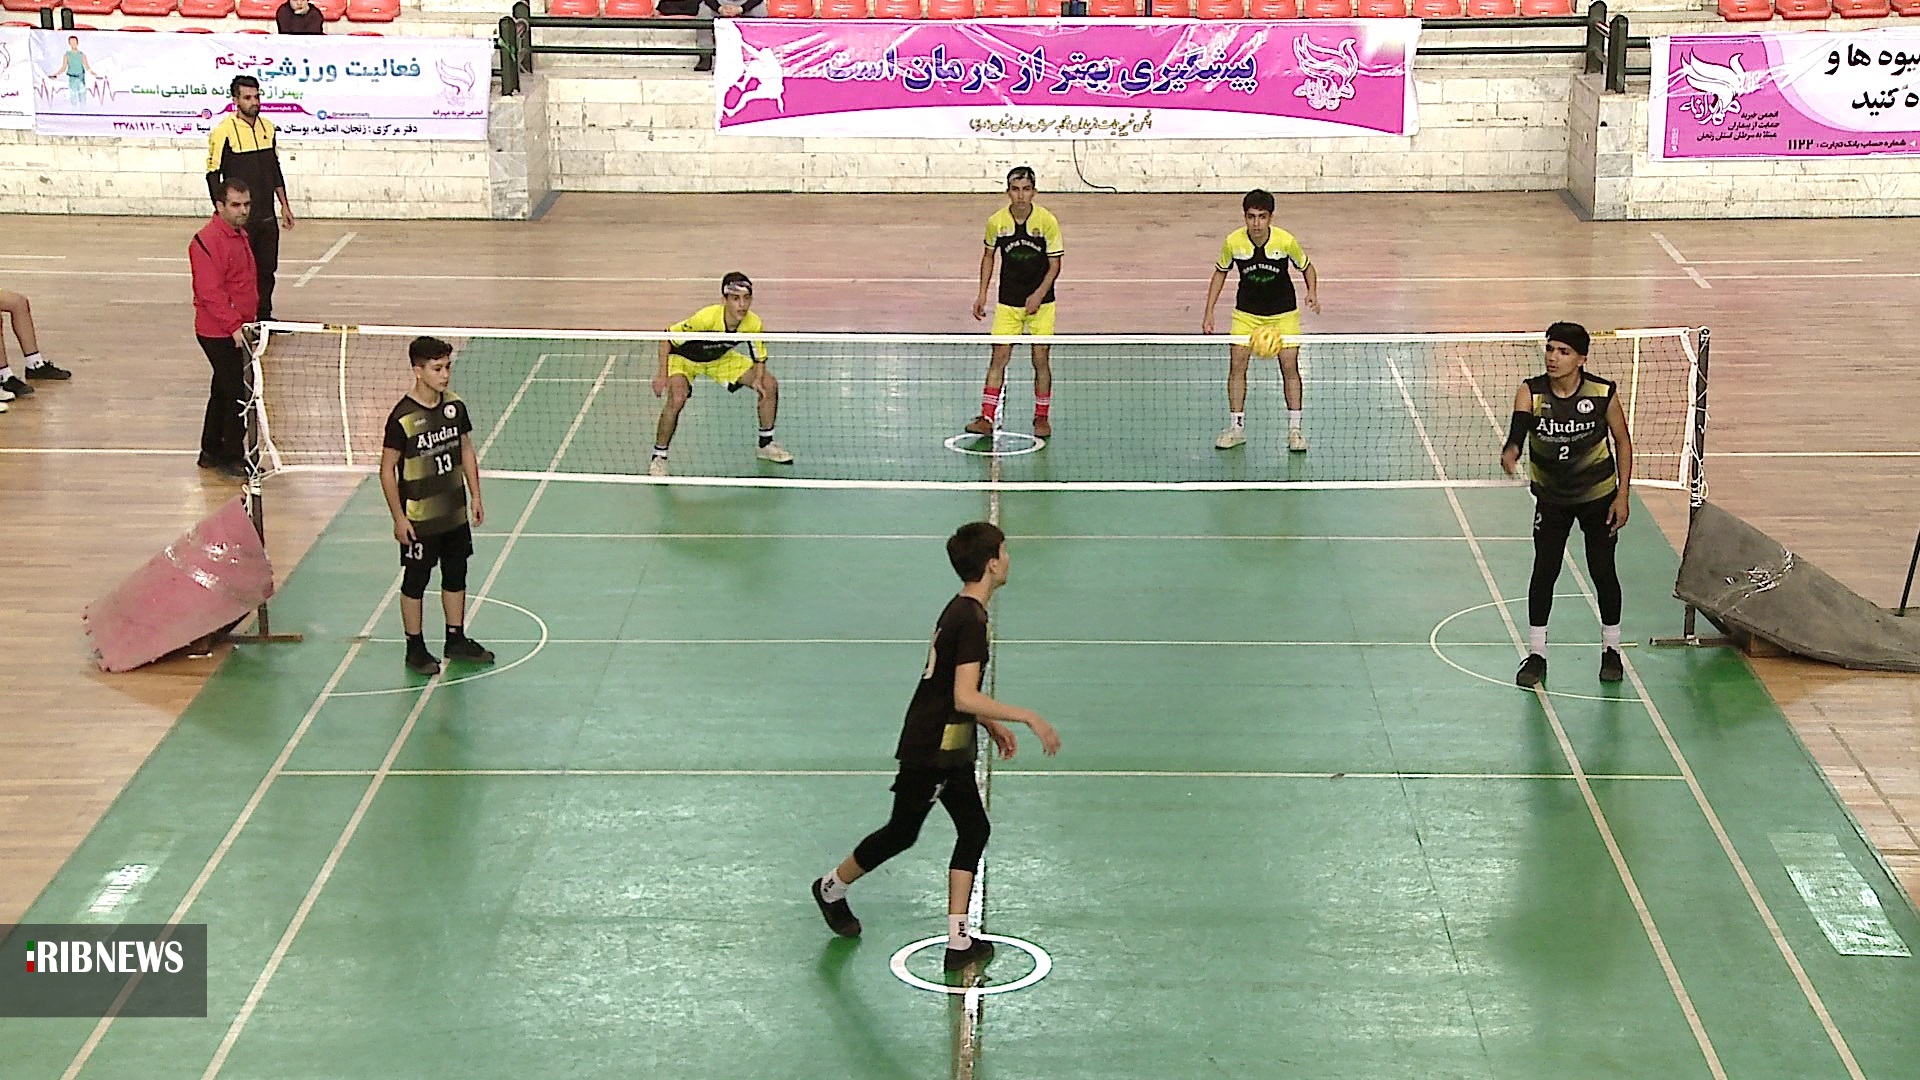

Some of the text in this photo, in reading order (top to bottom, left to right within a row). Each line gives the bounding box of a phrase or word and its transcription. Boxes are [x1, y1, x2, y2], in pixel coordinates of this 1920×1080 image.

[215, 53, 235, 69] کم
[825, 45, 1256, 93] پیشگیری بهتر از درمان است
[1824, 43, 1920, 76] یوه ها و
[257, 57, 337, 83] ورزشی
[345, 57, 421, 83] فعالیت
[131, 84, 160, 96] است
[161, 84, 207, 99] فعالیتی
[1852, 84, 1907, 116] کنید
[402, 123, 418, 136] دفتر
[1861, 140, 1883, 148] حساب
[1883, 139, 1907, 148] شماره
[1535, 417, 1596, 436] Ajudan
[1558, 445, 1570, 461] 2
[434, 453, 453, 475] 13
[404, 541, 424, 560] 13
